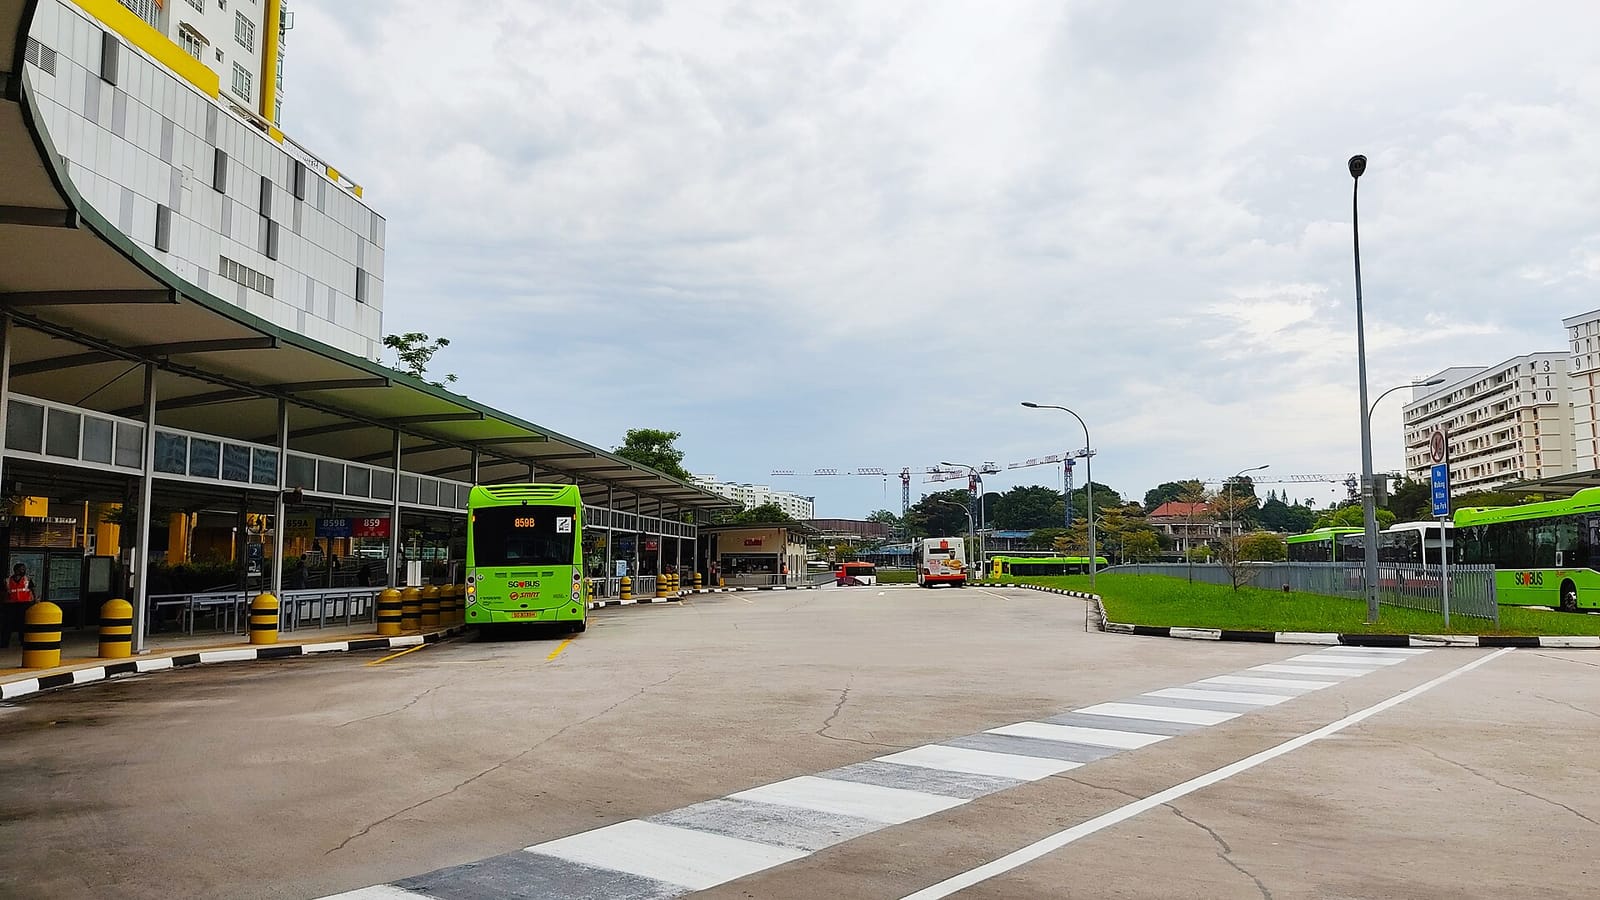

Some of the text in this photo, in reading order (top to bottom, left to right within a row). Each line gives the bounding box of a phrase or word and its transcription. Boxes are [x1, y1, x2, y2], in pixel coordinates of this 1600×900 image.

[287, 519, 309, 528] 859A
[323, 519, 345, 527] 859B
[364, 518, 381, 527] 859
[515, 517, 535, 528] 859B
